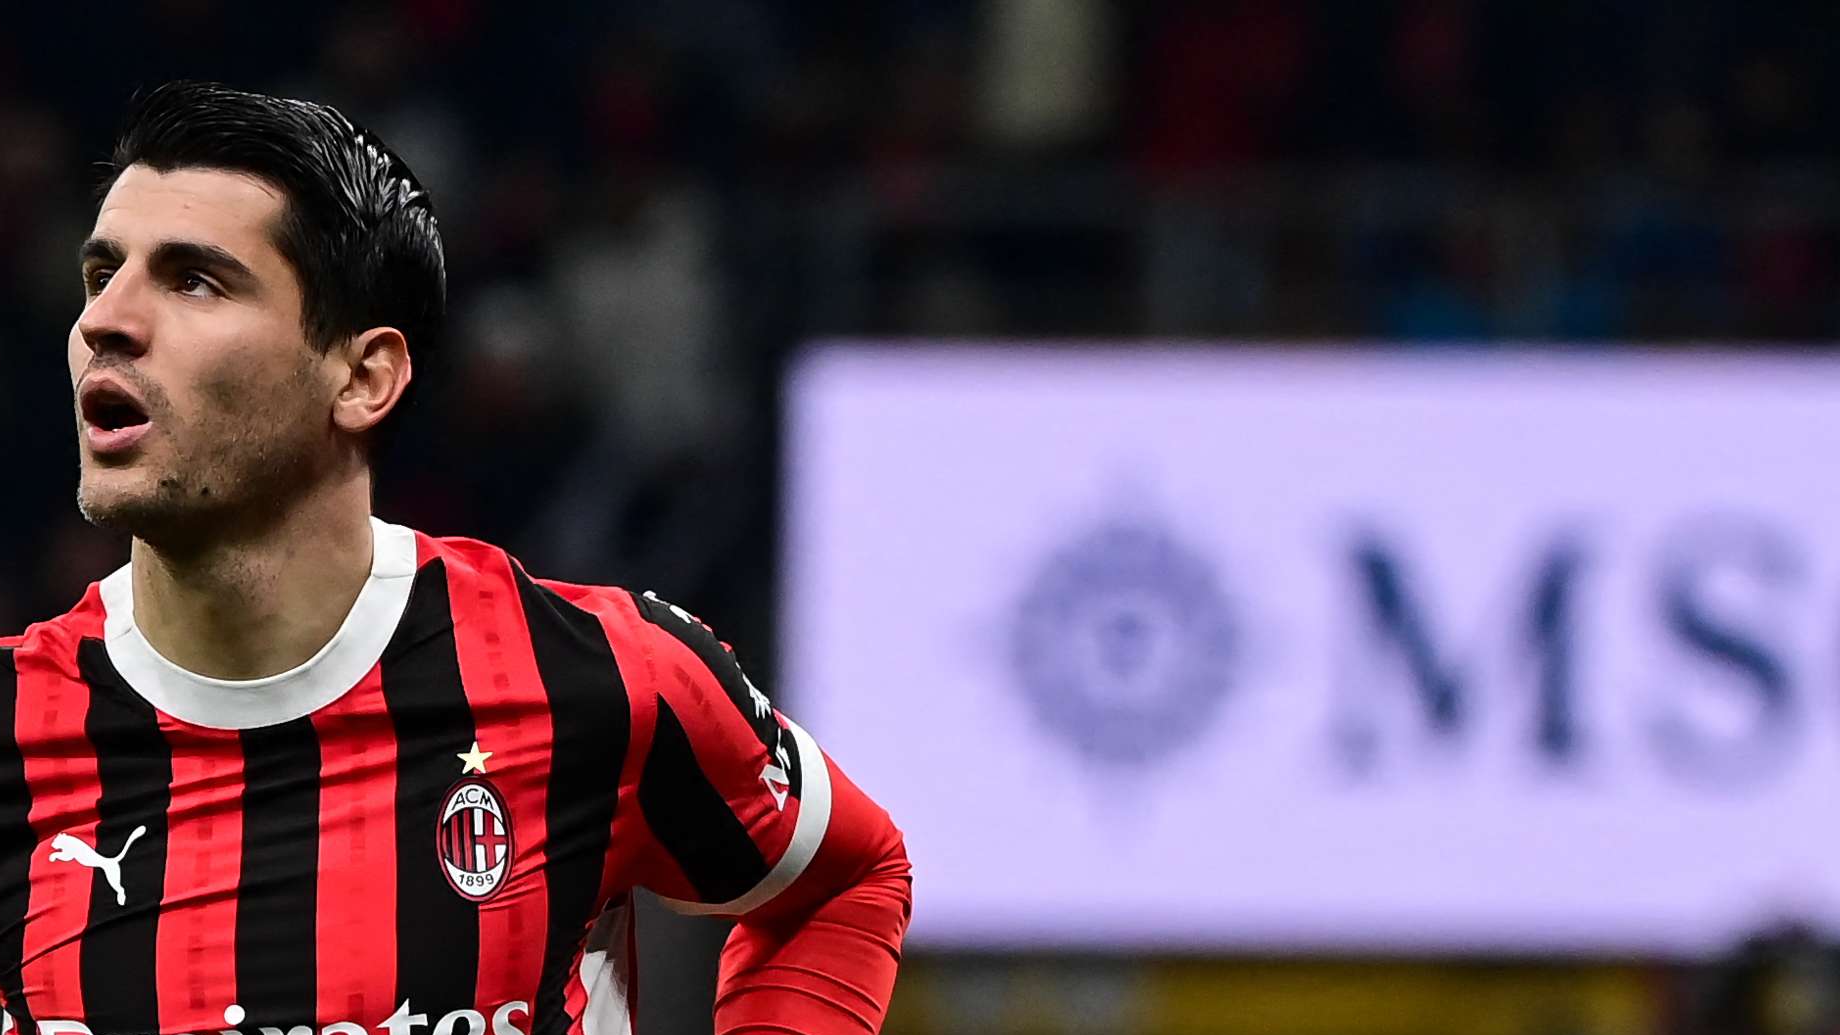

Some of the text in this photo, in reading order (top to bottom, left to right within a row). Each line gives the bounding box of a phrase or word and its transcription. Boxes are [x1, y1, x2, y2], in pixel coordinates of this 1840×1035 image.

[1325, 512, 1840, 795] MS
[451, 788, 495, 811] ACM
[459, 873, 495, 887] 1899
